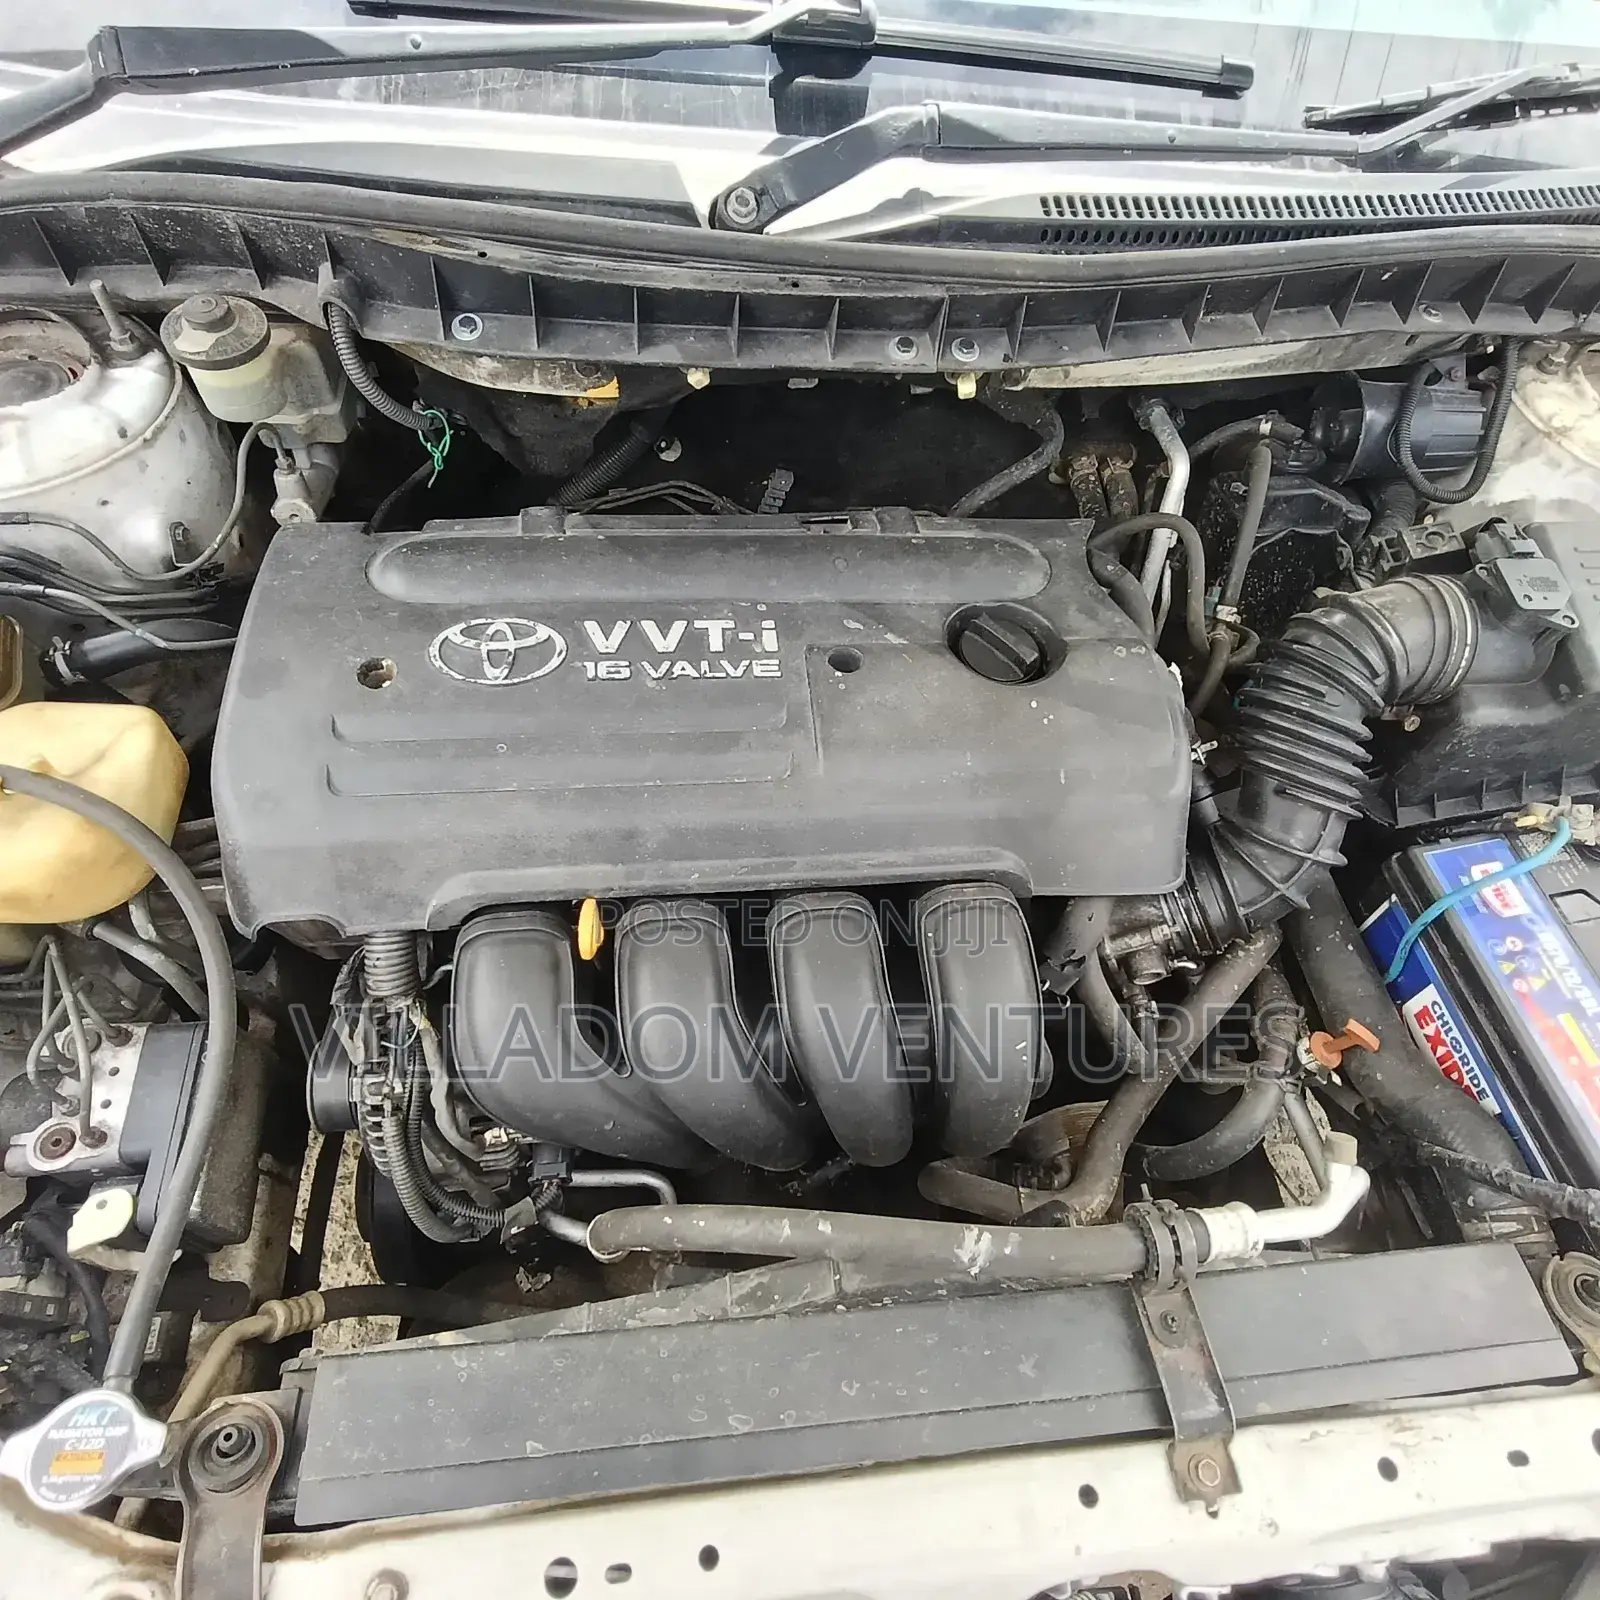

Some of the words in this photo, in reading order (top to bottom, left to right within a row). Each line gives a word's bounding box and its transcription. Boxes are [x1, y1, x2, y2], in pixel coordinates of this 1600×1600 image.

[582, 619, 780, 654] VVT-i
[582, 660, 633, 682] 16
[640, 659, 783, 681] VALVE
[1430, 1000, 1490, 1101] CHLORIDE
